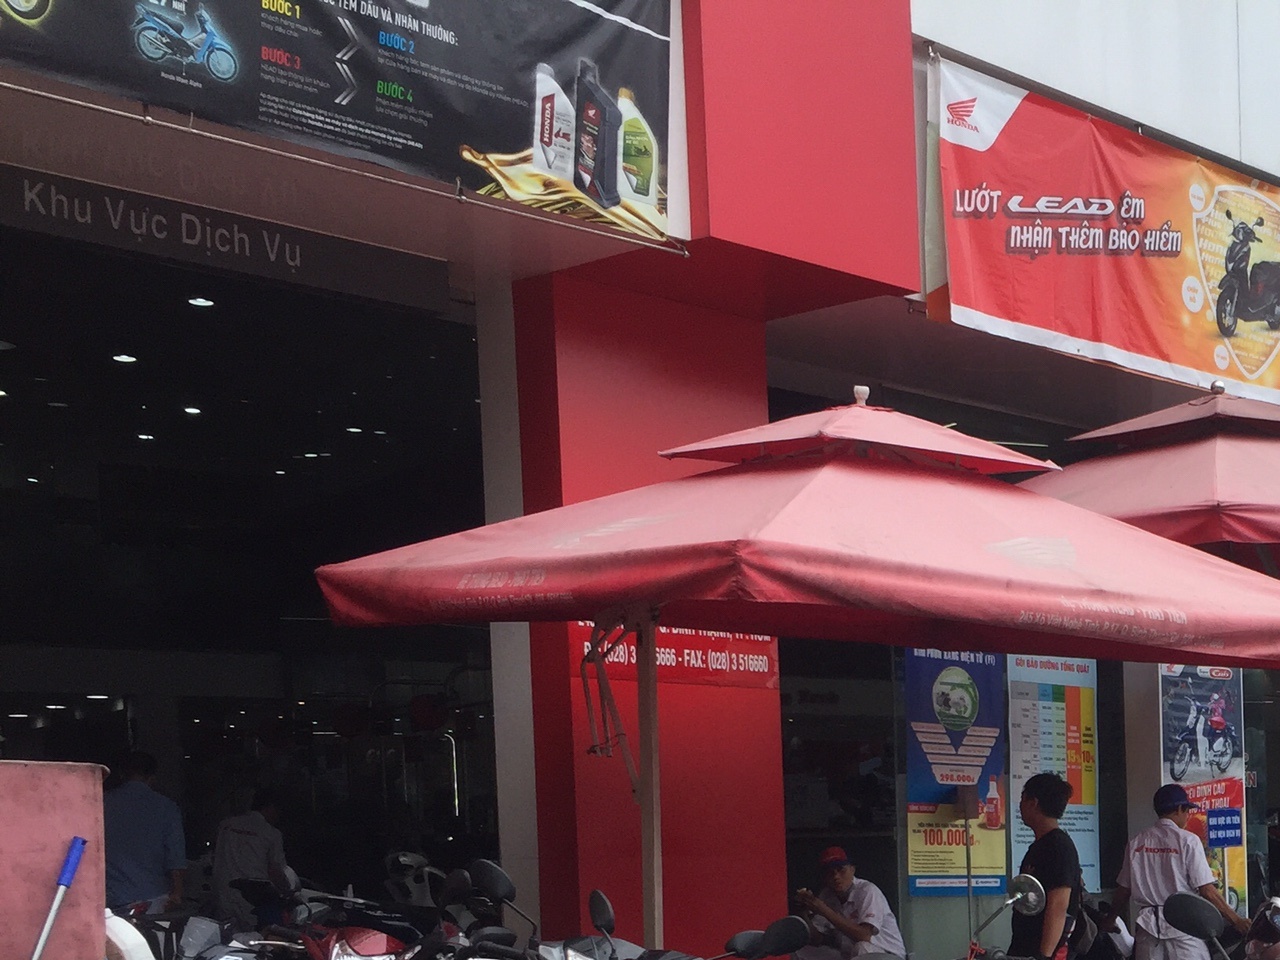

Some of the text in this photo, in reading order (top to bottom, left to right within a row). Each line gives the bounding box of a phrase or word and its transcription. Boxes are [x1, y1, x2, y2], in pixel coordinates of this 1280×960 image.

[408, 40, 415, 55] 2
[294, 55, 300, 70] 3
[406, 89, 414, 103] 4
[543, 102, 551, 143] HONDA
[946, 116, 980, 133] HONDA
[955, 182, 1002, 214] LƯỚT
[1006, 195, 1116, 216] LEAD
[23, 179, 300, 273] Khu Vực Dịch Vụ
[1058, 221, 1104, 249] THÊM
[1108, 223, 1139, 251] BẢO
[630, 645, 637, 664] 3
[683, 649, 706, 669] FAX:
[708, 649, 730, 673] (028)
[731, 653, 738, 671] 3
[739, 654, 769, 674] 516660
[1144, 847, 1179, 855] HONDA
